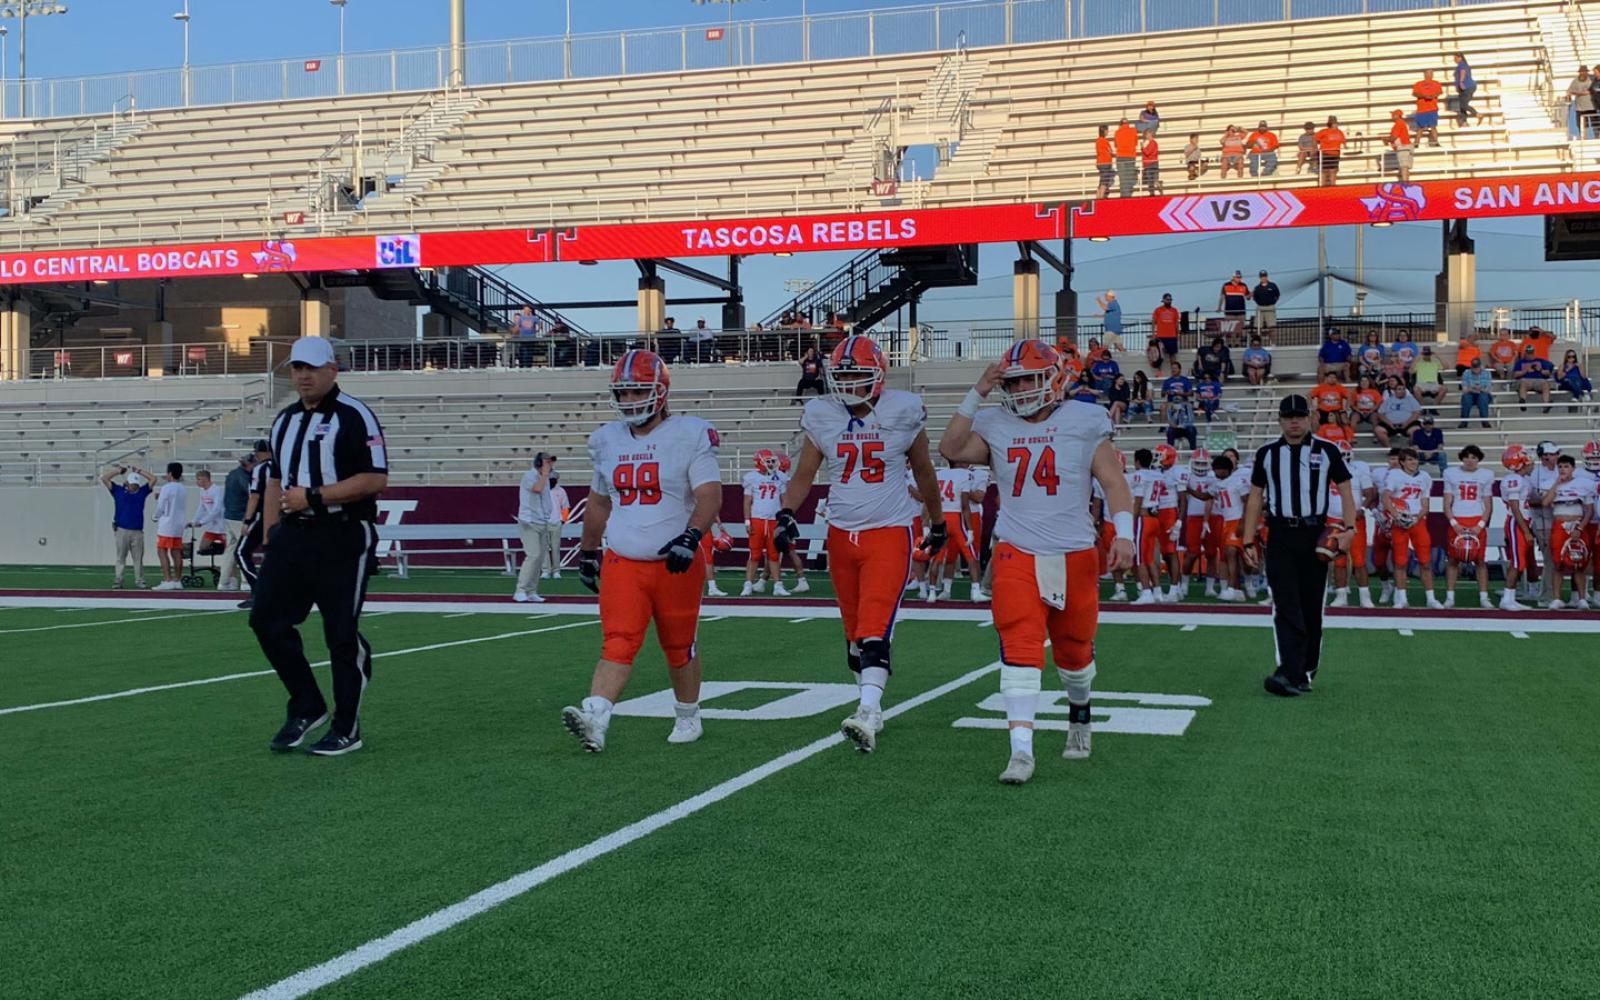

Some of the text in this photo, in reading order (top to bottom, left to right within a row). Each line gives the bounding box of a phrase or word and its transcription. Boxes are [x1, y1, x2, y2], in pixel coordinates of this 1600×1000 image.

[1454, 179, 1600, 210] SAN ANG
[1210, 199, 1252, 222] VS
[681, 218, 917, 249] TASCOSA REBELS
[0, 248, 240, 277] LO CENTRAL BOBCATS
[837, 441, 886, 484] 75
[1007, 445, 1060, 497] 74
[759, 484, 777, 499] 77
